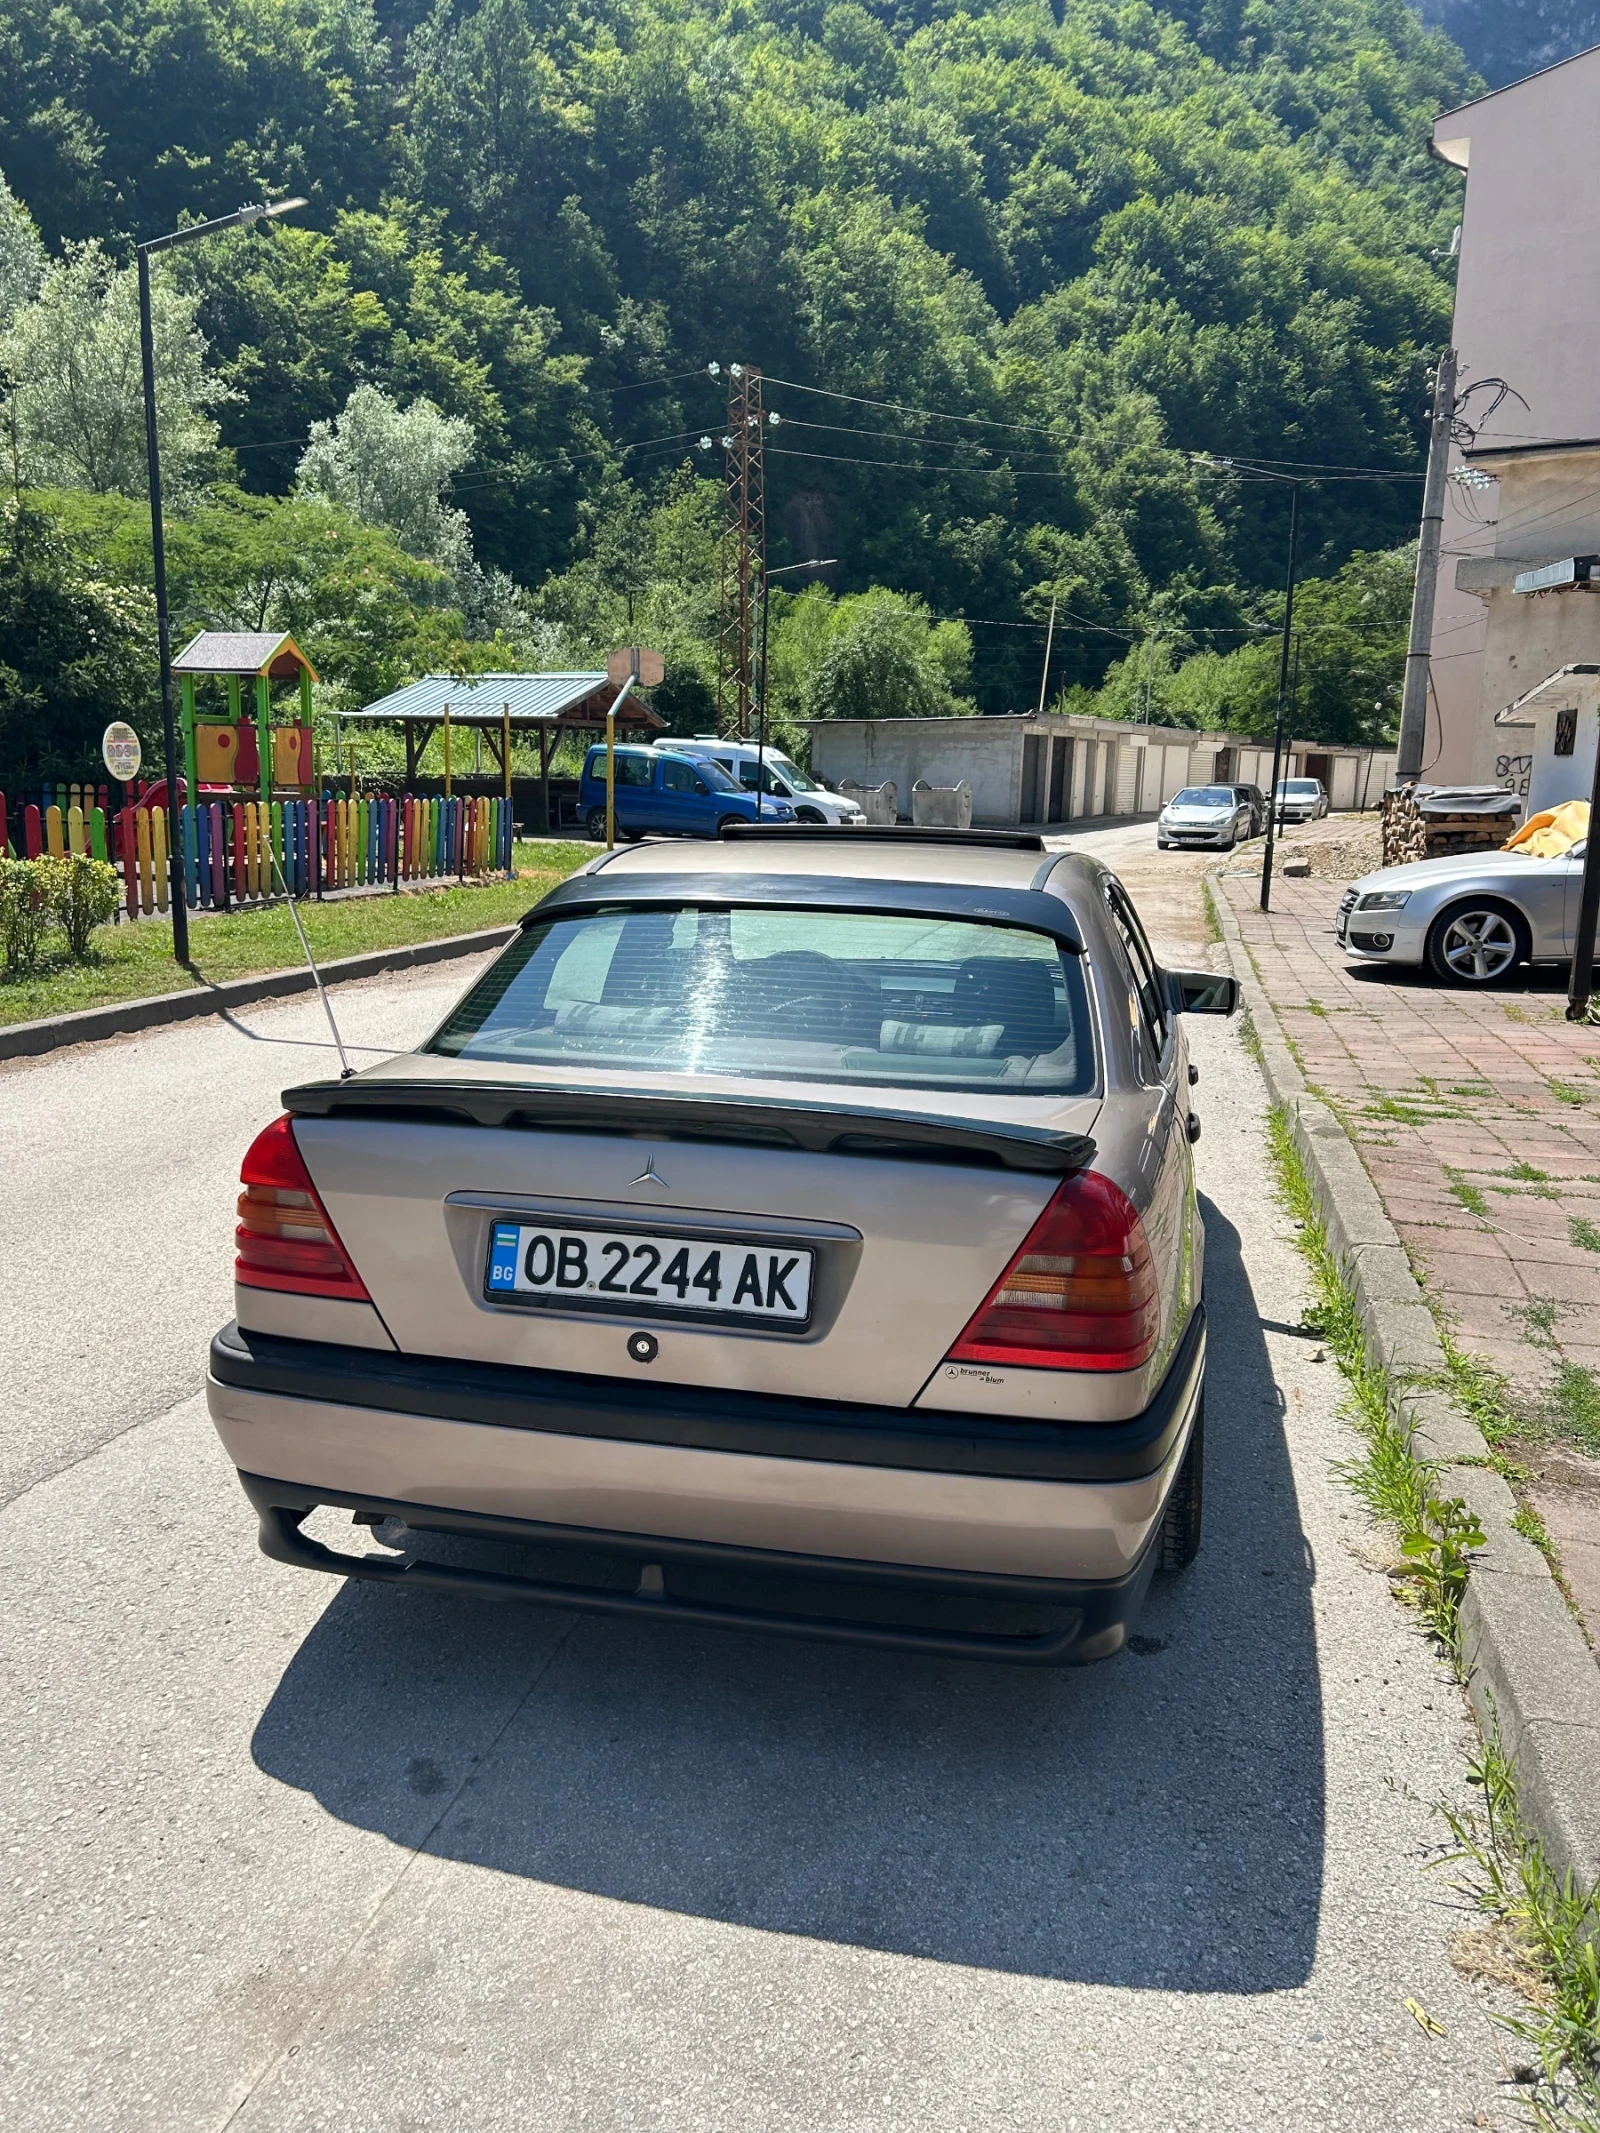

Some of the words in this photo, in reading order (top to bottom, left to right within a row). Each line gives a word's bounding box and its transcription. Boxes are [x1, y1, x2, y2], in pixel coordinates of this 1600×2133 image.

[492, 1265, 514, 1282] BG
[524, 1234, 589, 1288] OB
[598, 1240, 724, 1302] 2244
[732, 1253, 800, 1311] AK
[960, 1367, 991, 1377] brunner
[985, 1376, 1005, 1384] blum
